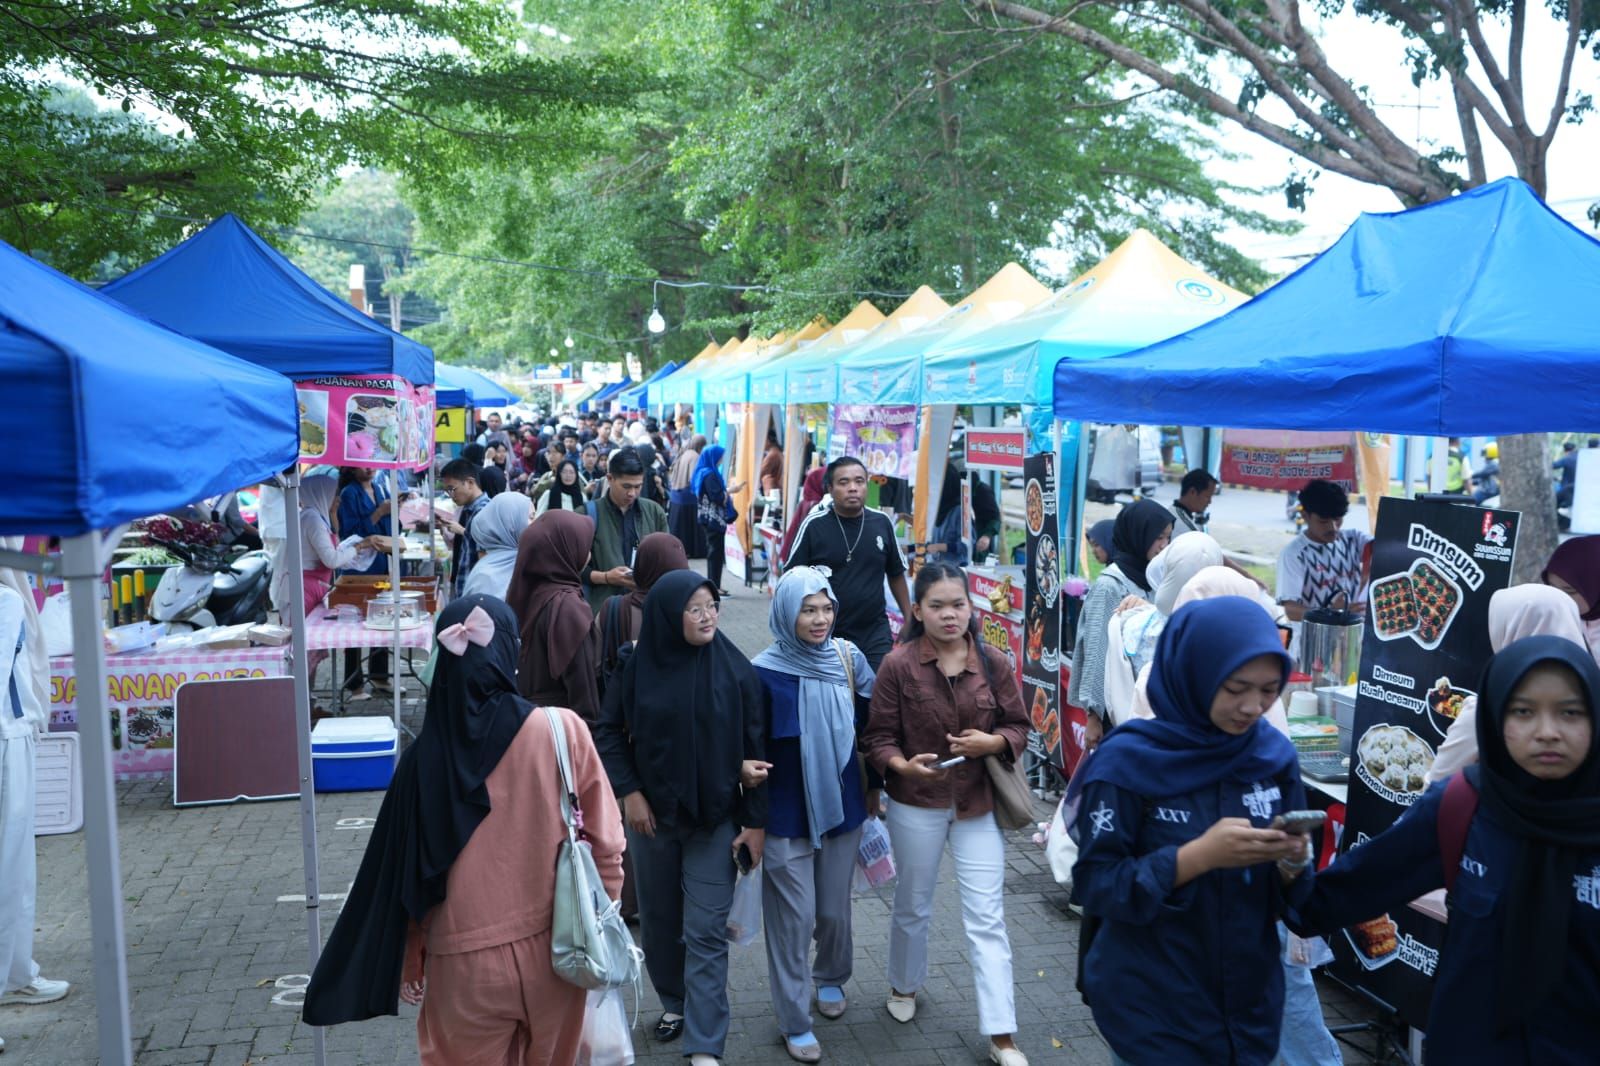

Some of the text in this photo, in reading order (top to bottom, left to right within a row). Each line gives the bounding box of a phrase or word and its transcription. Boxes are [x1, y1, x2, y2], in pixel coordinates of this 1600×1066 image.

[1410, 525, 1482, 588] Dimsum
[983, 615, 1008, 651] Sate
[50, 672, 186, 703] JAANAN
[1374, 666, 1413, 688] Dimsum
[1357, 763, 1394, 801] Dimsum
